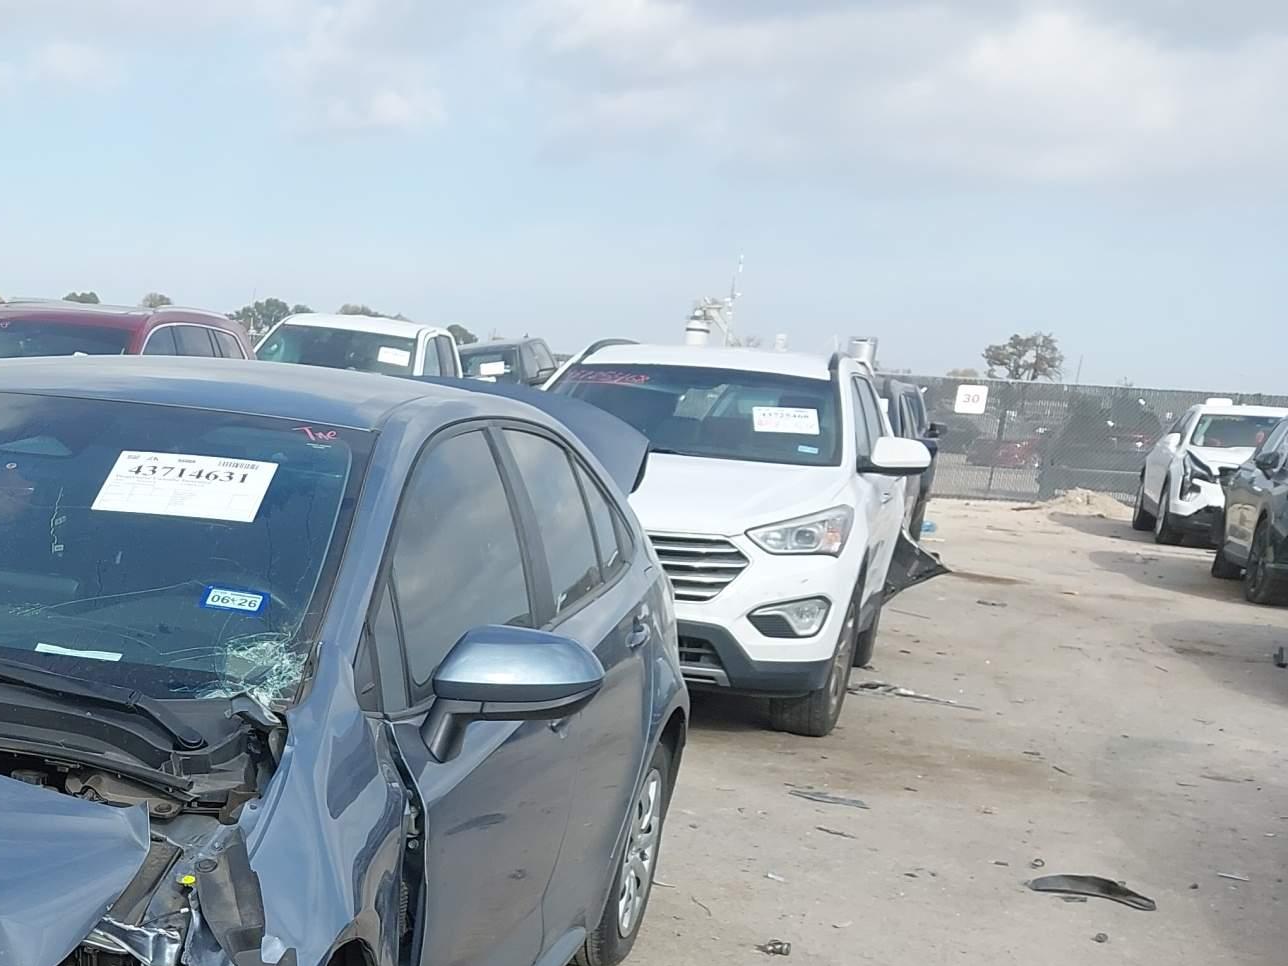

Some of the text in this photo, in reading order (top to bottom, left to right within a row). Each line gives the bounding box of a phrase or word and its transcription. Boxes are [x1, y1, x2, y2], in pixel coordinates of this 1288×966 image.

[962, 393, 980, 403] 30
[128, 464, 249, 483] 43714631
[210, 594, 258, 608] 06 26
